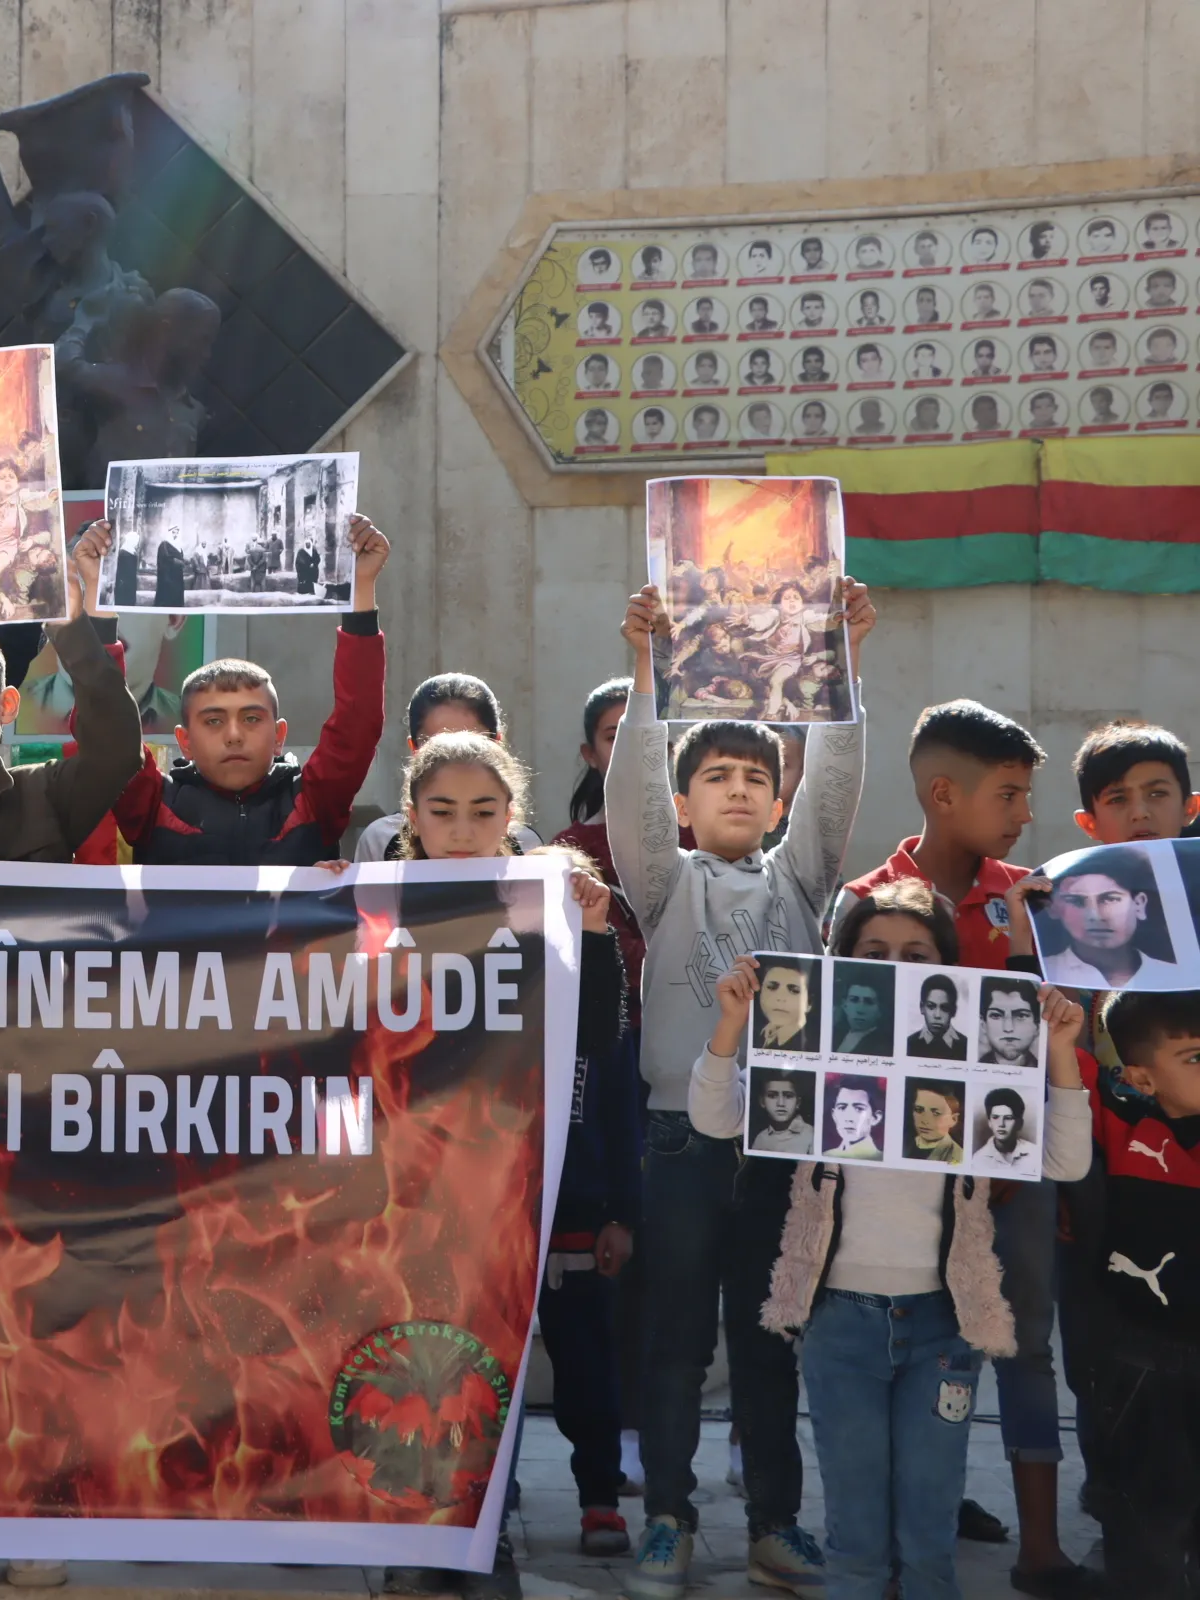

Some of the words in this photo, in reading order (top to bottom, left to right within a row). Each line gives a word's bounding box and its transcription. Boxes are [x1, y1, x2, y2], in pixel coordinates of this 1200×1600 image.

[254, 926, 523, 1032] AMÛDÊ
[50, 1048, 373, 1156] BÎRKIRIN
[391, 1323, 479, 1353] Zarokan
